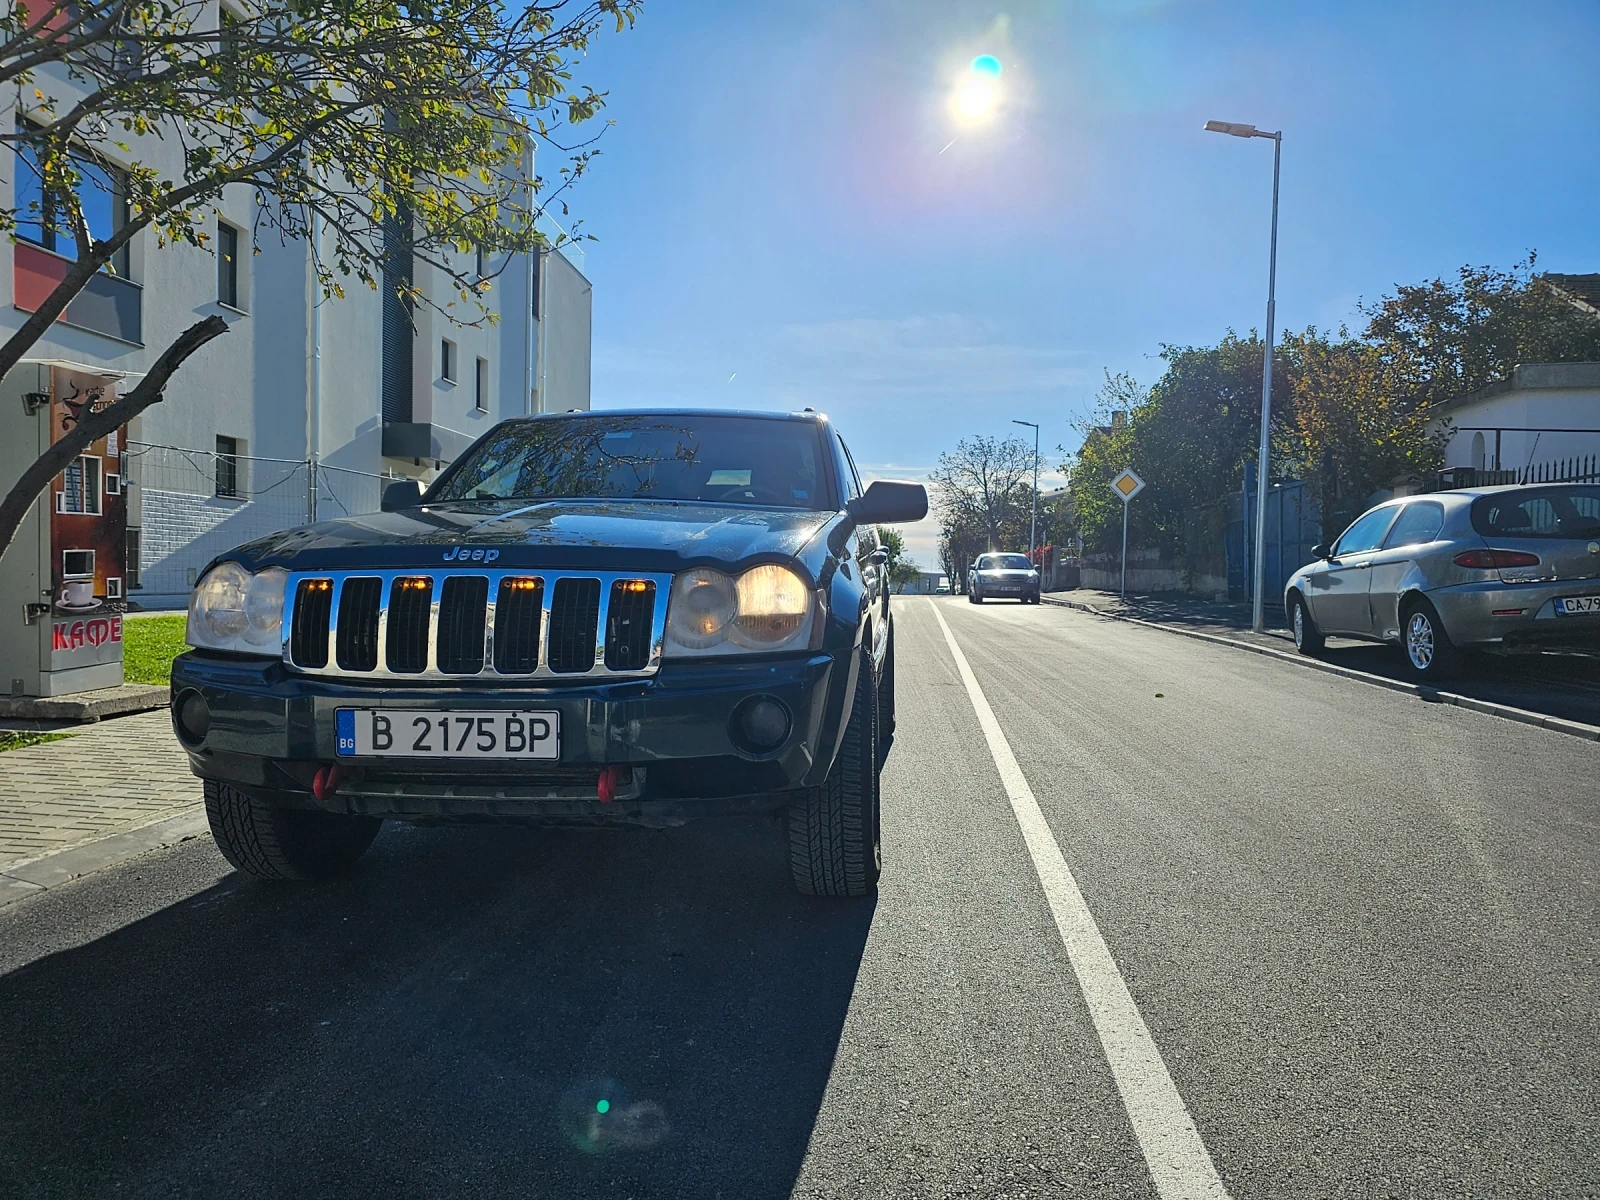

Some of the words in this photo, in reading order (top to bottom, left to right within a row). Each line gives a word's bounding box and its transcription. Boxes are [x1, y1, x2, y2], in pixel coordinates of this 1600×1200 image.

[442, 546, 500, 564] Jeep
[53, 616, 122, 652] КАФЕ
[340, 737, 354, 749] BG
